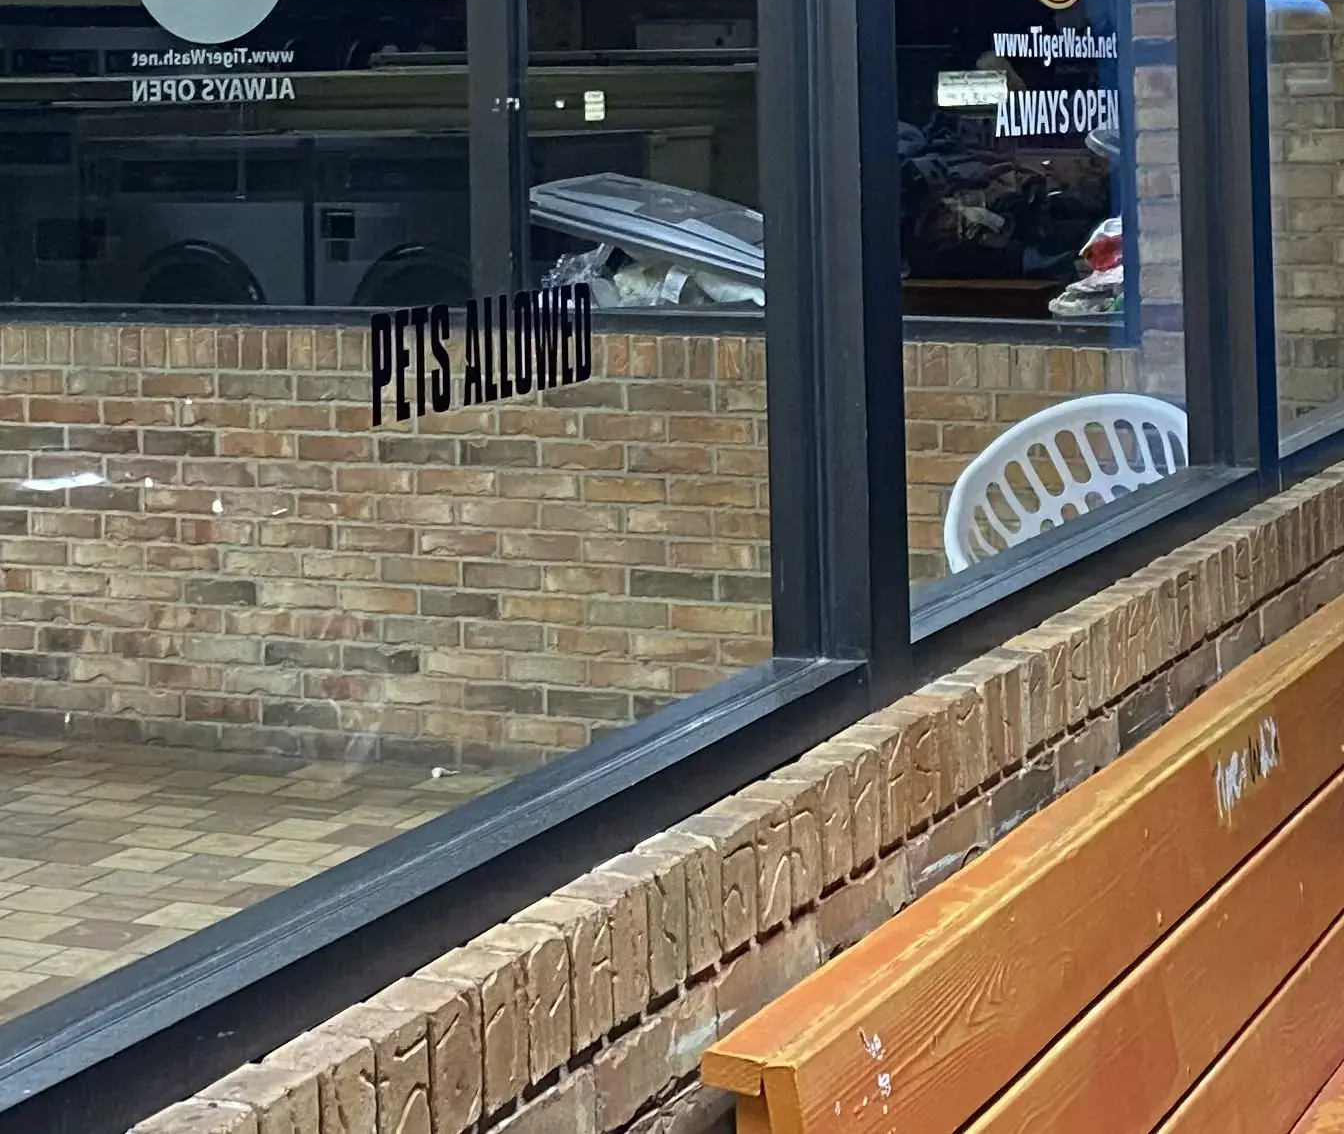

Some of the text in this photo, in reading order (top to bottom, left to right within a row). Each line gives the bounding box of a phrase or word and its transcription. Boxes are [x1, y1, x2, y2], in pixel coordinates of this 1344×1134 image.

[993, 25, 1118, 67] www.TigerWash.net
[994, 89, 1119, 138] ALWAYS OPEN
[371, 282, 592, 427] PETS ALLOWED
